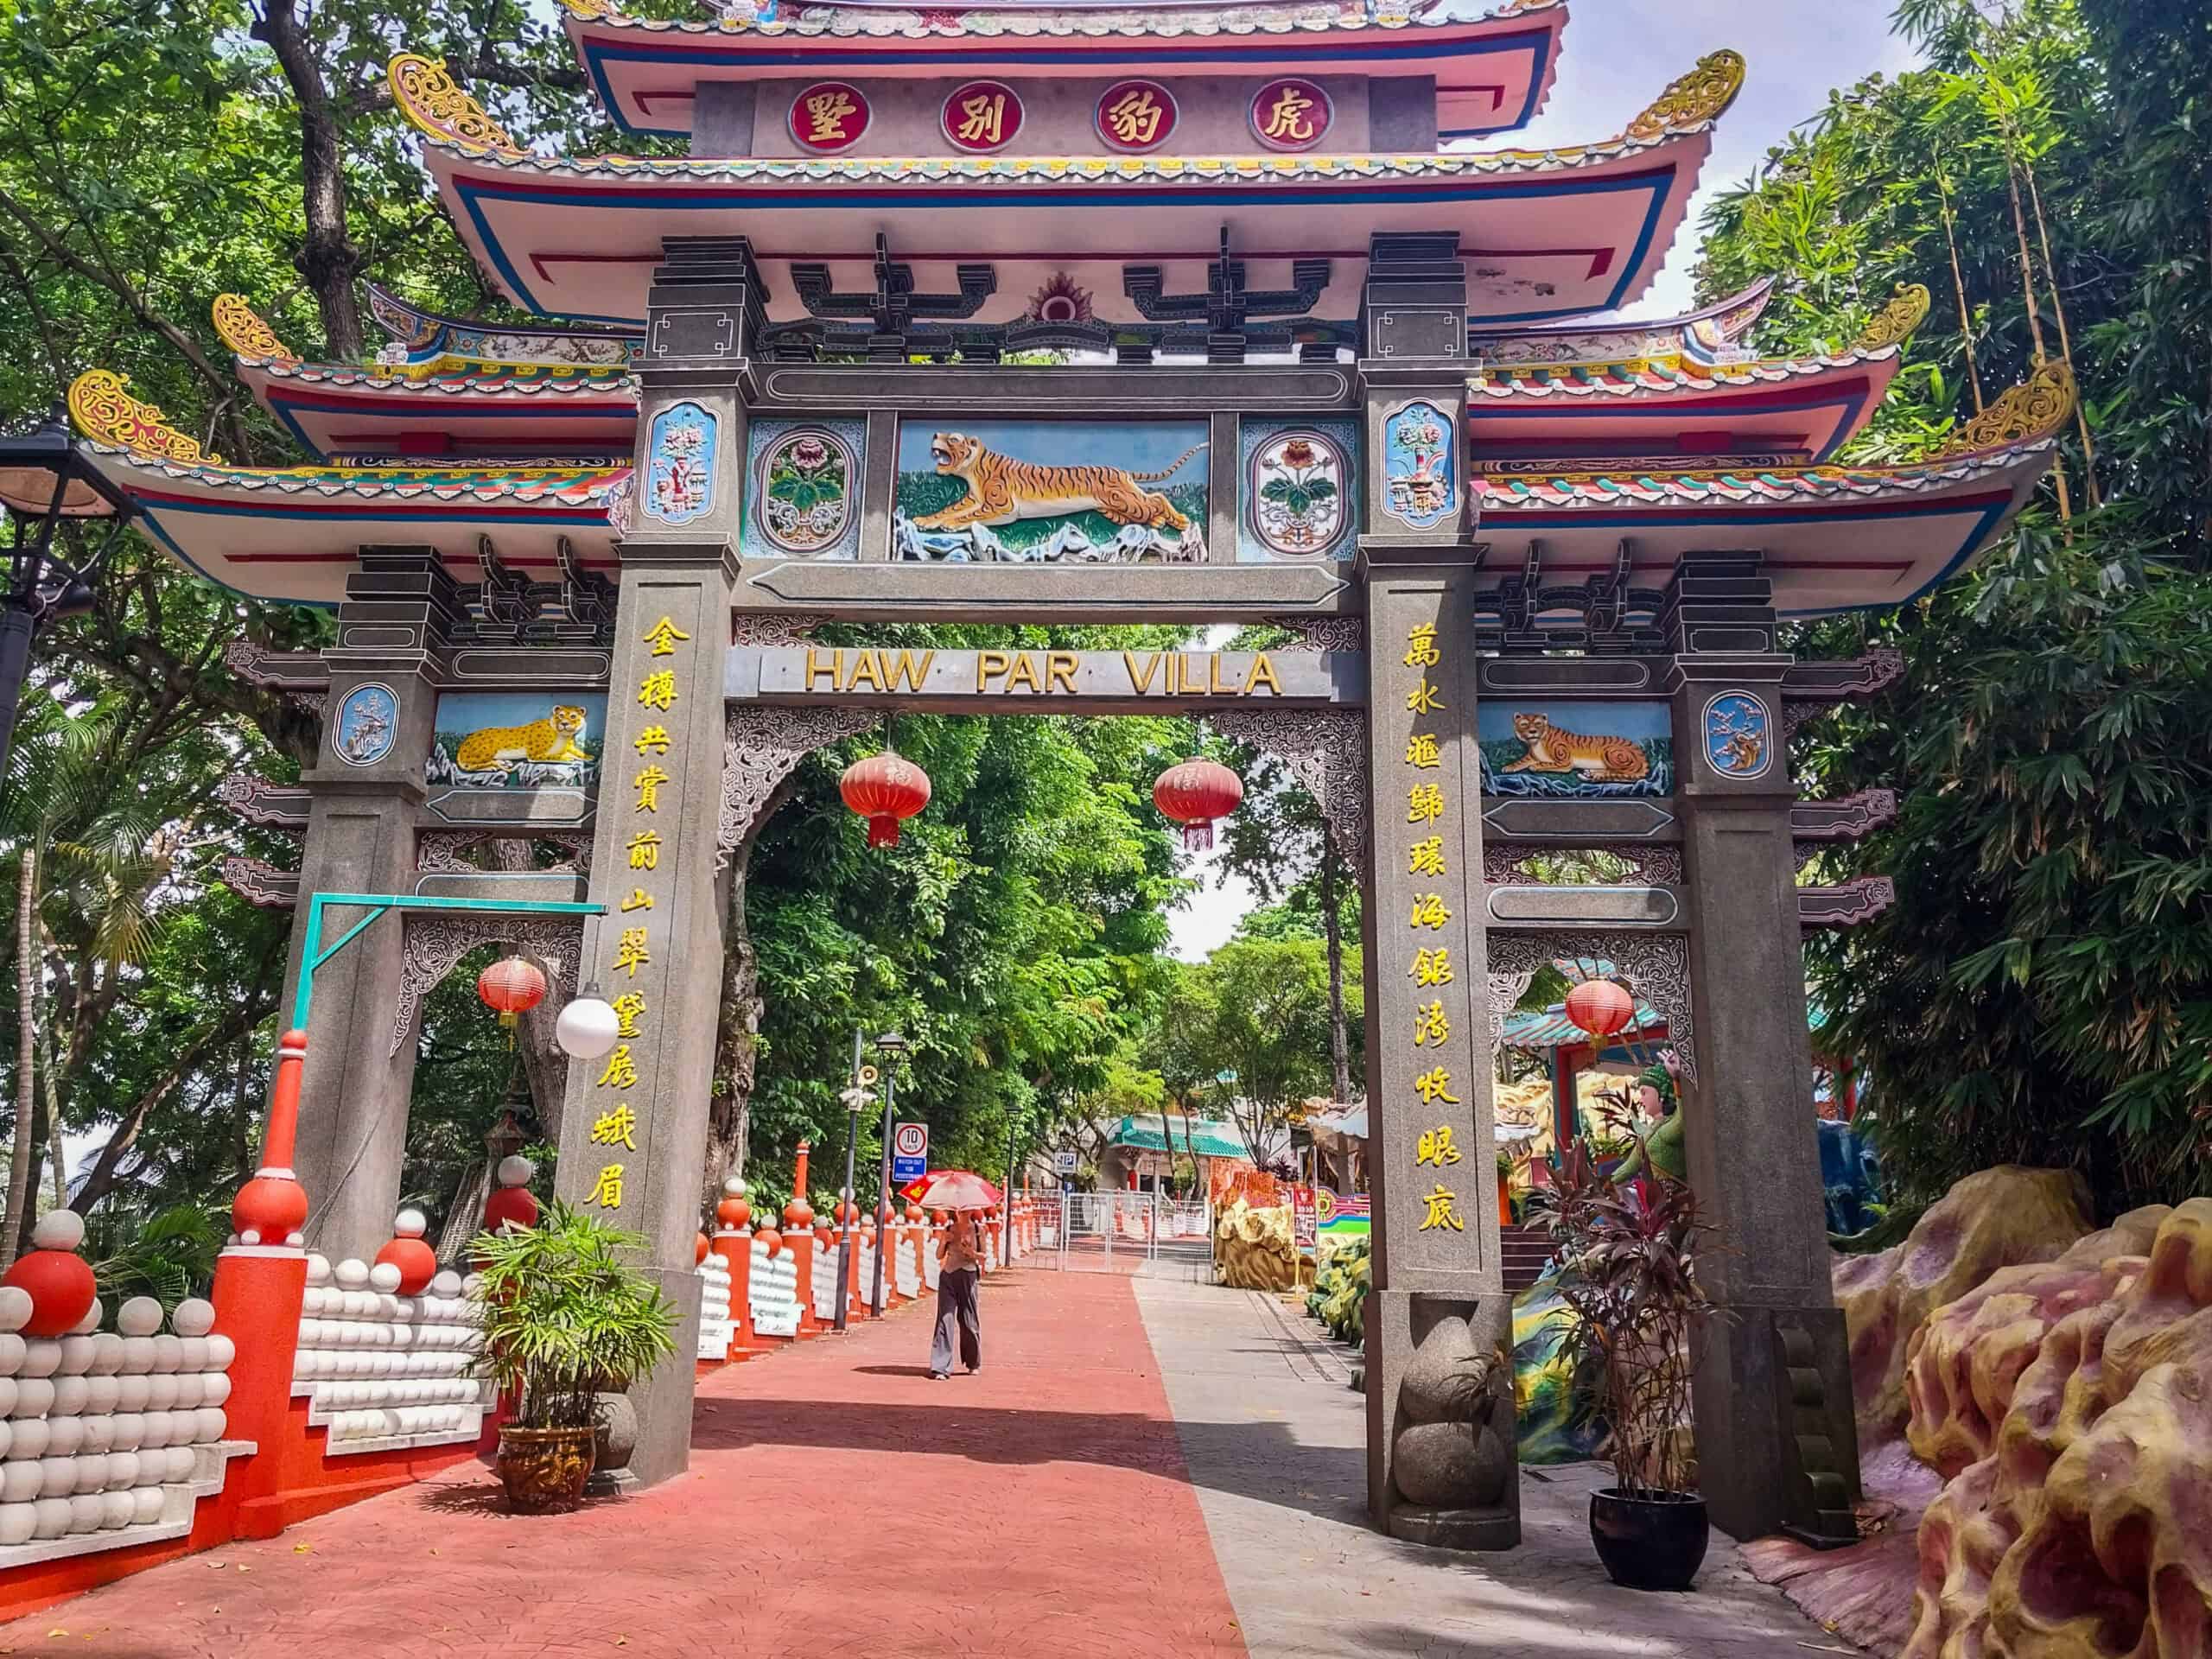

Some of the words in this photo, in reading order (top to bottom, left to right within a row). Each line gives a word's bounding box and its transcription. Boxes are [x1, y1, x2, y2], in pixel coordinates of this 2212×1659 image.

[805, 649, 935, 692] HAW
[976, 652, 1077, 693] PAR
[1125, 652, 1281, 695] VILLA
[906, 1130, 918, 1144] 10
